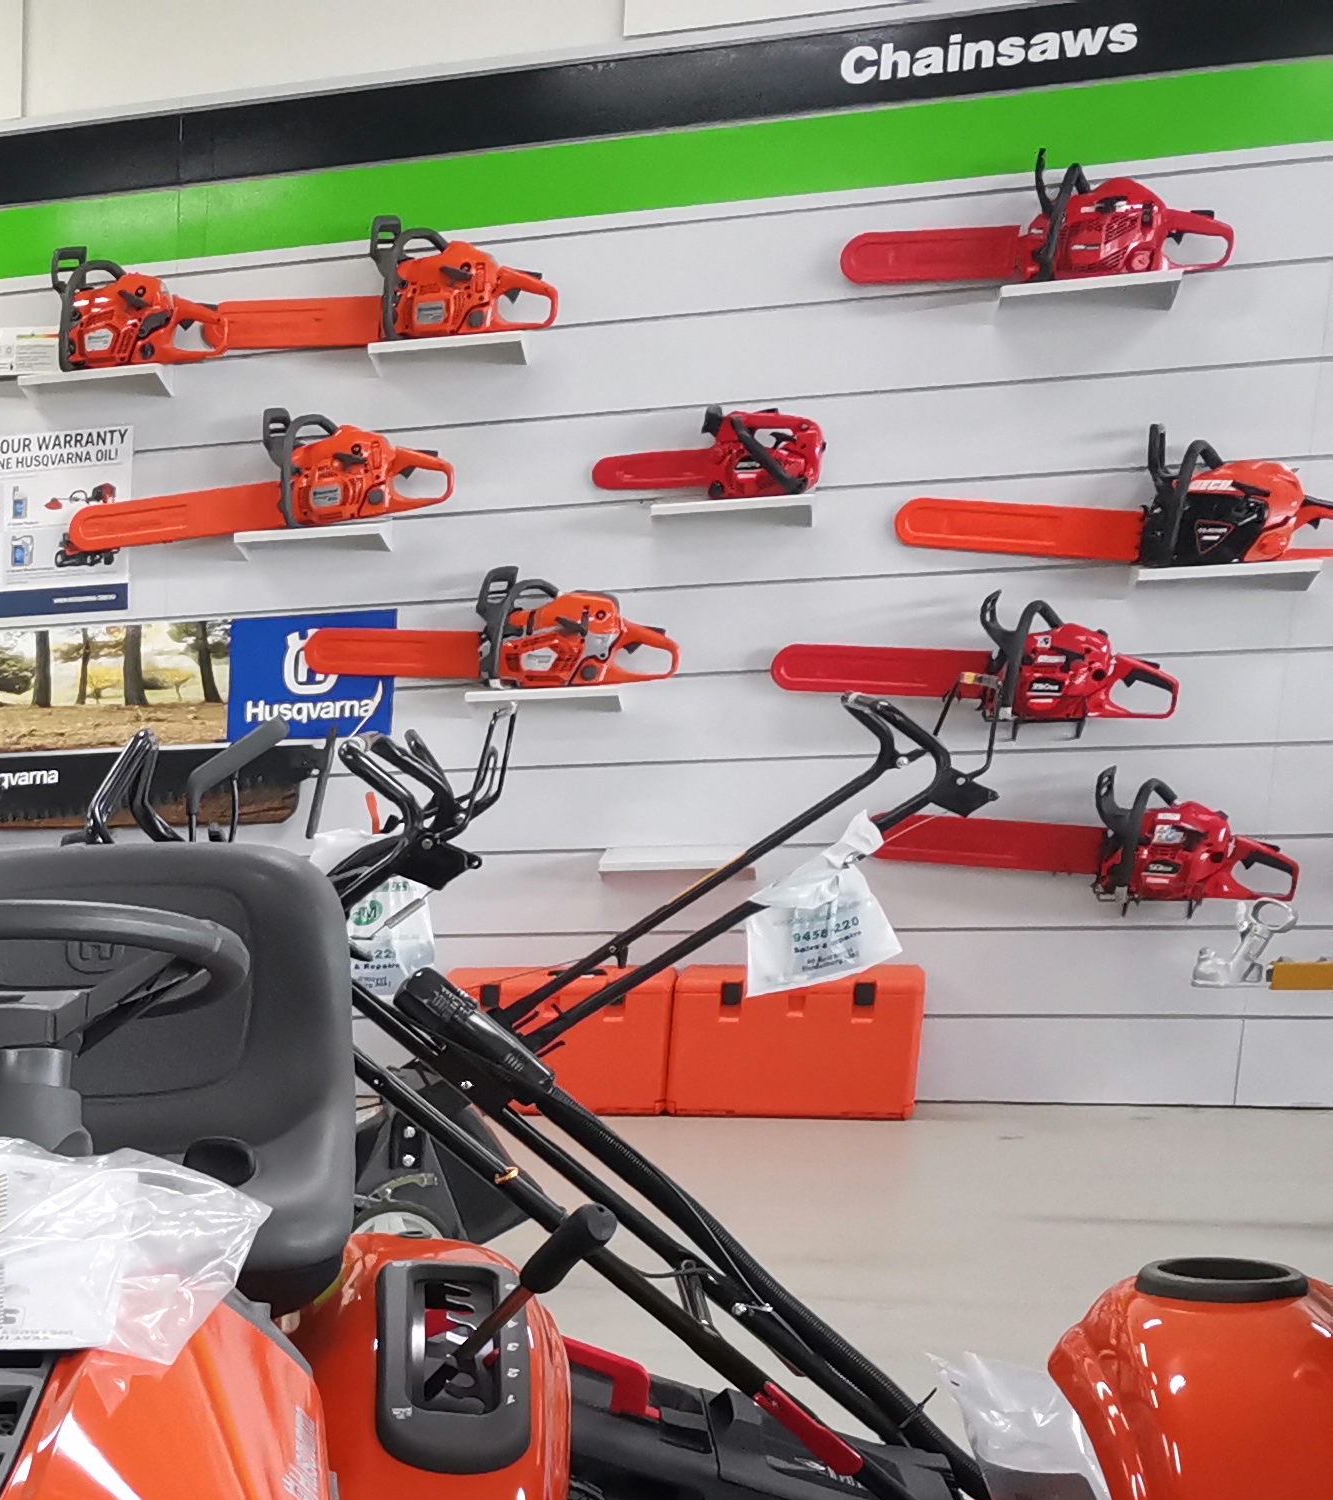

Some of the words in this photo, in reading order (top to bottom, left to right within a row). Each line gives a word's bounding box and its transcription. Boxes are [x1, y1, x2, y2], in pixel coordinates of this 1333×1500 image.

[840, 22, 1138, 85] Chainsaws
[37, 429, 128, 451] WARRANTY
[16, 451, 92, 469] HUSQVARNA
[95, 448, 119, 461] OIL!
[245, 699, 374, 724] Husqvarna
